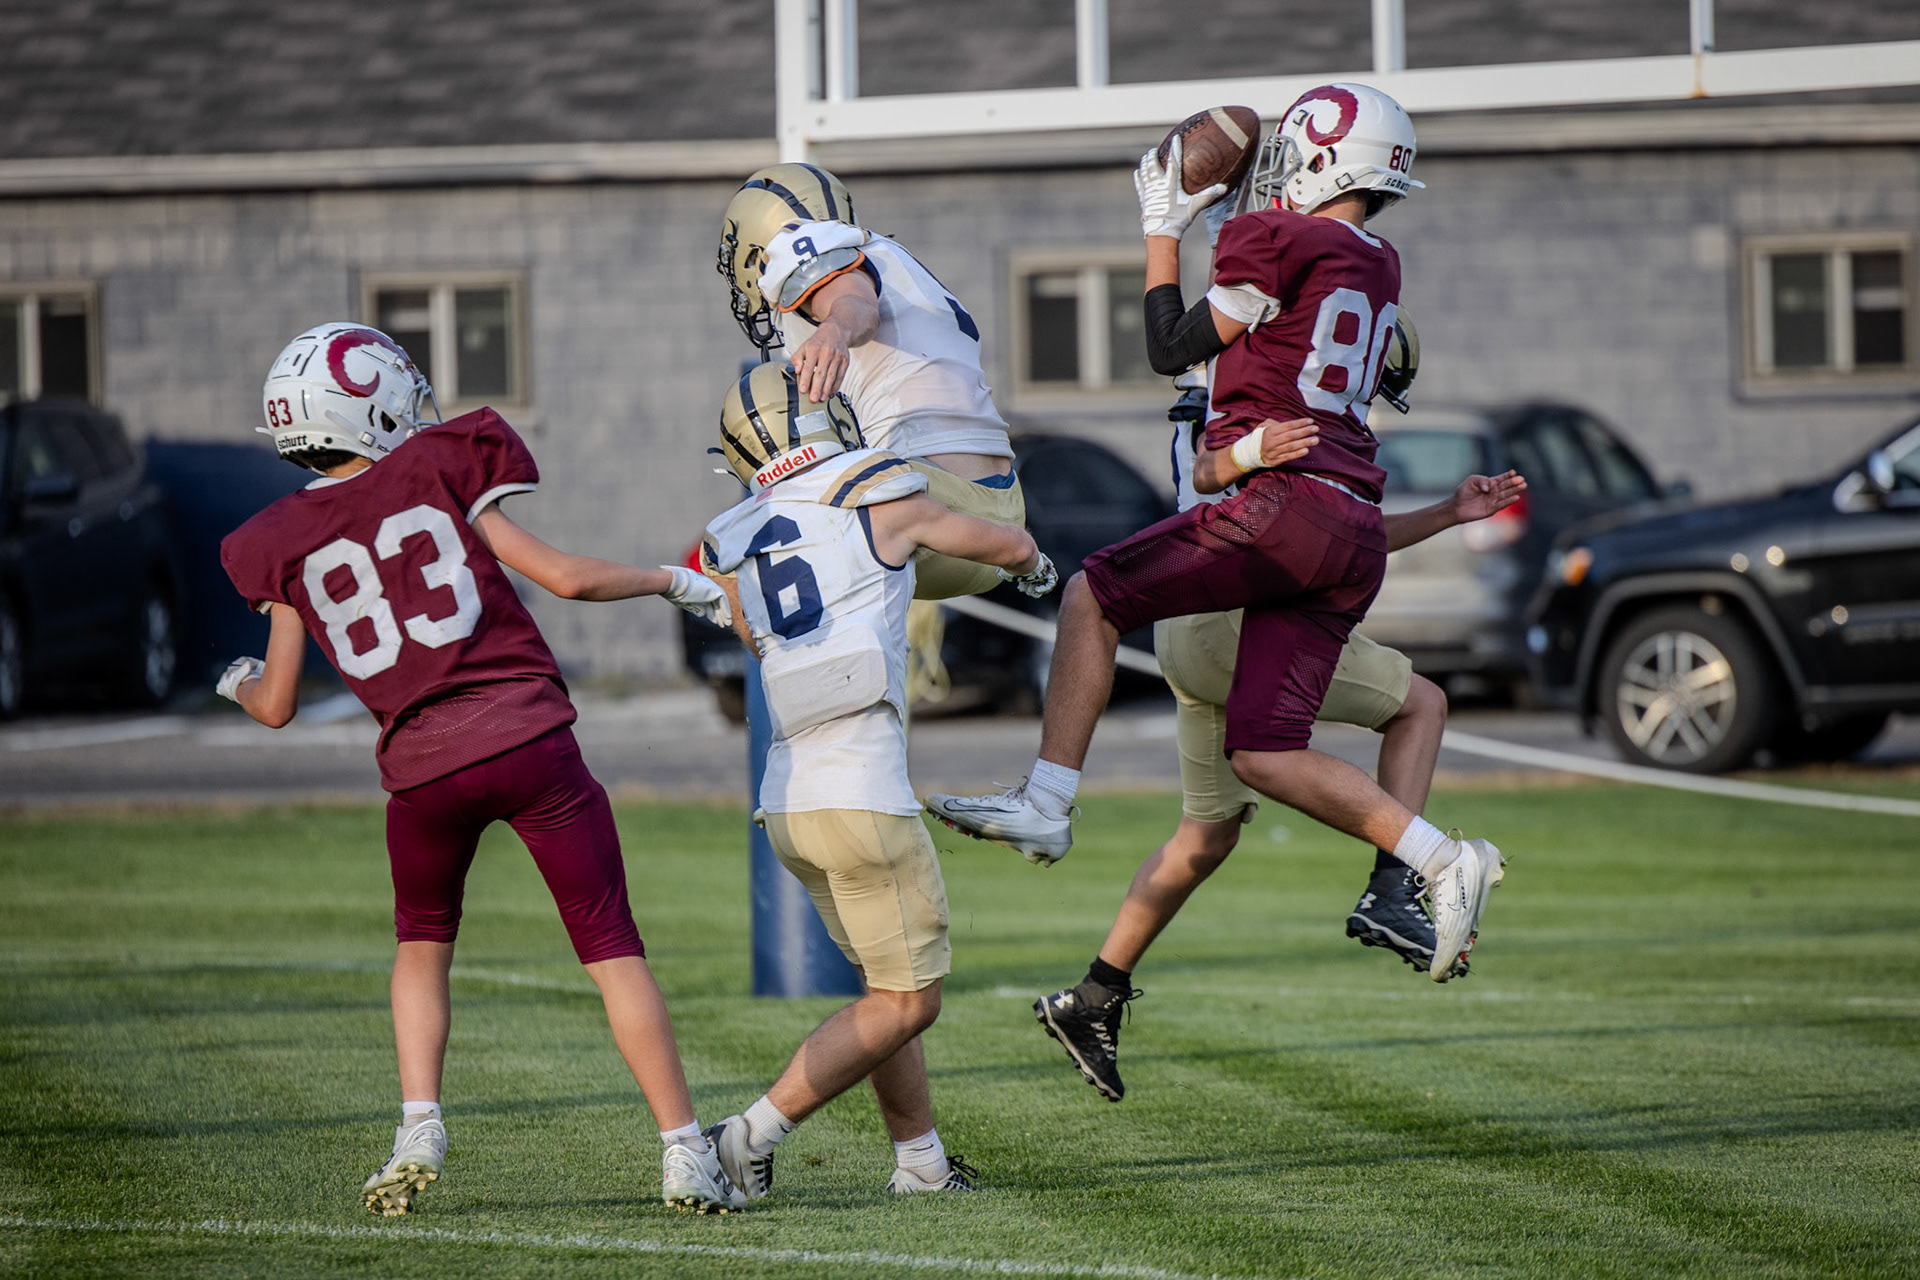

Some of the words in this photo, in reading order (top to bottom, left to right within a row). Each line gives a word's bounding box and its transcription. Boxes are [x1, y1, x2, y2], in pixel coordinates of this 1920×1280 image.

[1389, 144, 1413, 174] 80
[792, 236, 819, 267] 9
[267, 397, 293, 428] 83
[278, 434, 308, 450] schutt
[756, 446, 817, 488] Riddell
[302, 503, 483, 681] 83
[743, 514, 825, 641] 6
